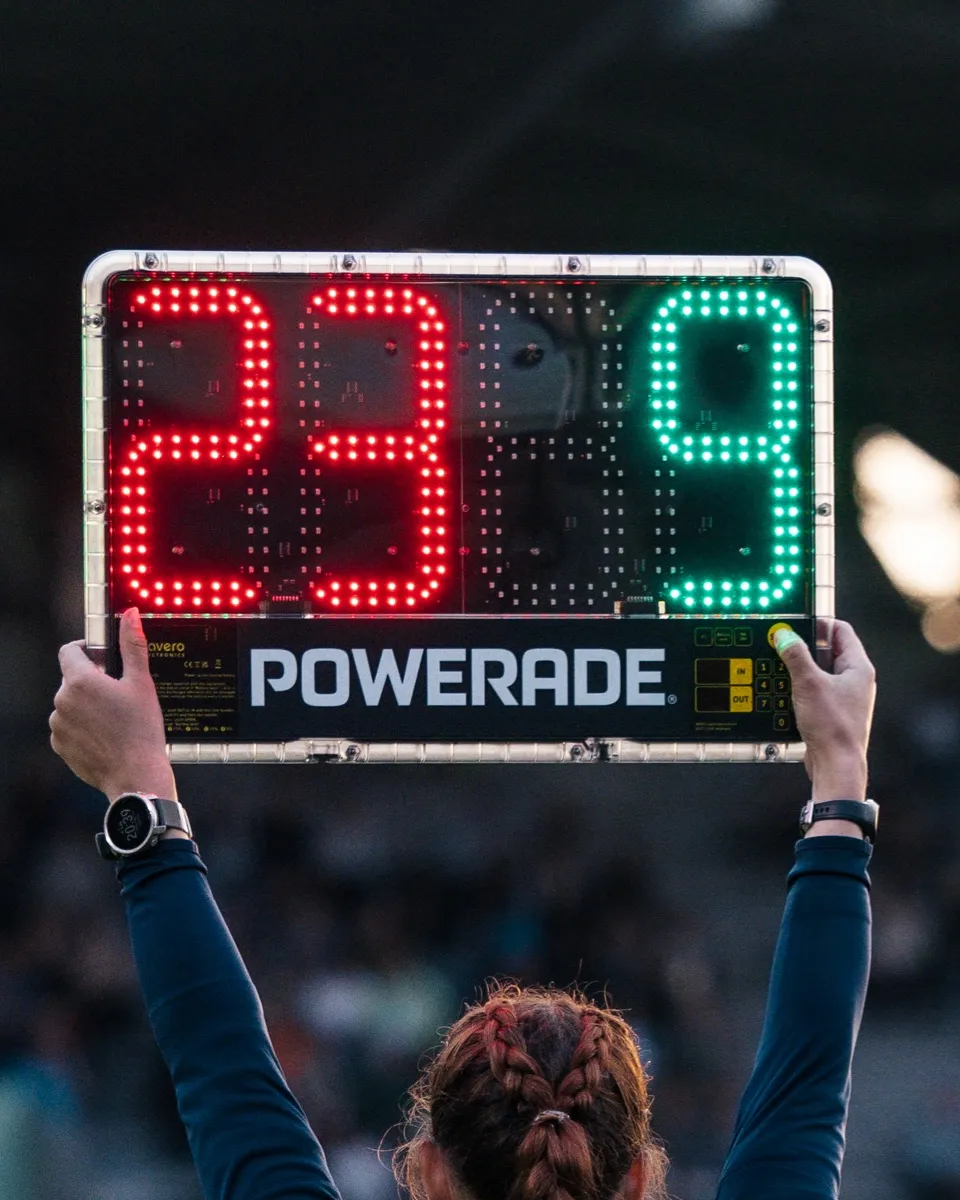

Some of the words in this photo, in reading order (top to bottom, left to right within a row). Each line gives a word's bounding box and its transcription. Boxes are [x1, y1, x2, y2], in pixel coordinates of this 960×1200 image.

[119, 285, 448, 608] 23
[650, 287, 799, 608] 9
[149, 642, 185, 652] avero
[736, 667, 746, 675] IN
[250, 647, 665, 707] POWERADE
[732, 695, 749, 703] OUT
